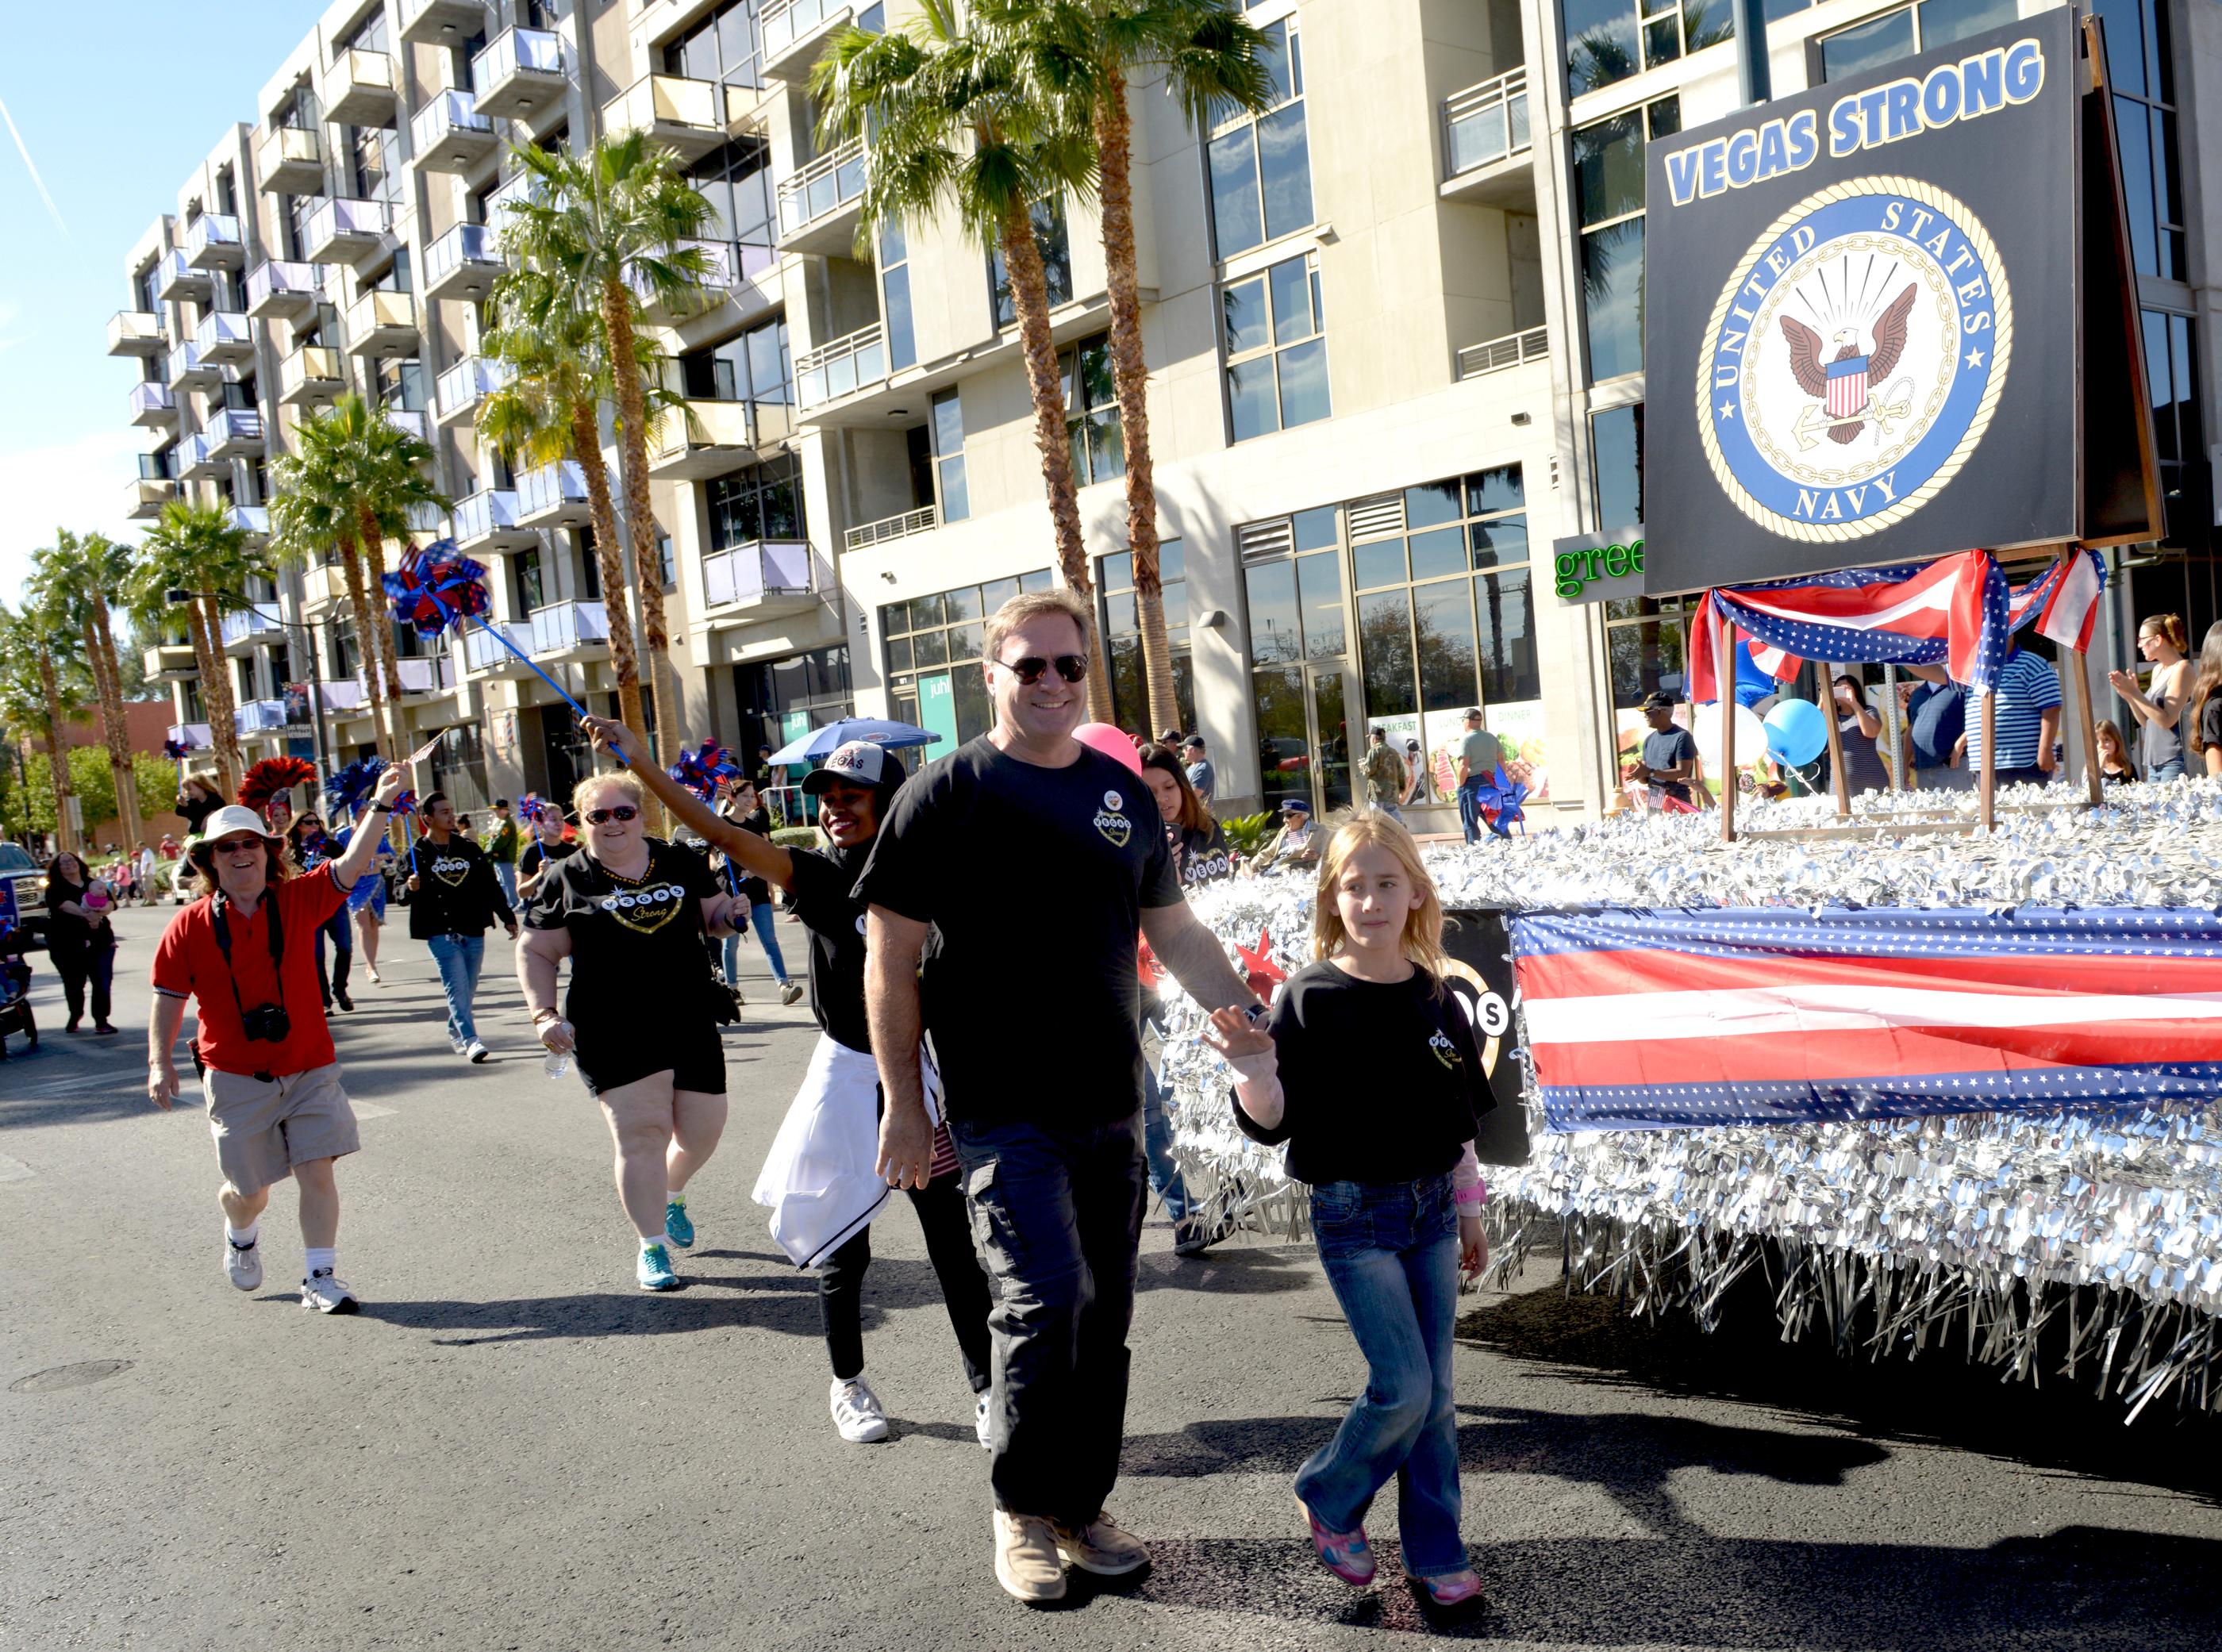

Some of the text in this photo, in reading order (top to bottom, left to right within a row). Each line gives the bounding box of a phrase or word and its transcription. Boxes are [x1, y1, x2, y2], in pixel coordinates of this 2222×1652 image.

[1664, 38, 2045, 206] VEGAS STRONG
[1716, 202, 1990, 390] UNITED STATES
[1792, 471, 1897, 519] NAVY
[930, 678, 950, 698] juhl
[792, 712, 806, 730] juhl
[1498, 709, 1531, 721] DINNER
[1094, 818, 1132, 828] VEGAS
[431, 861, 470, 873] VEGAS
[1185, 857, 1228, 882] VEGA
[602, 886, 685, 910] VEGAS
[631, 906, 667, 921] Strong
